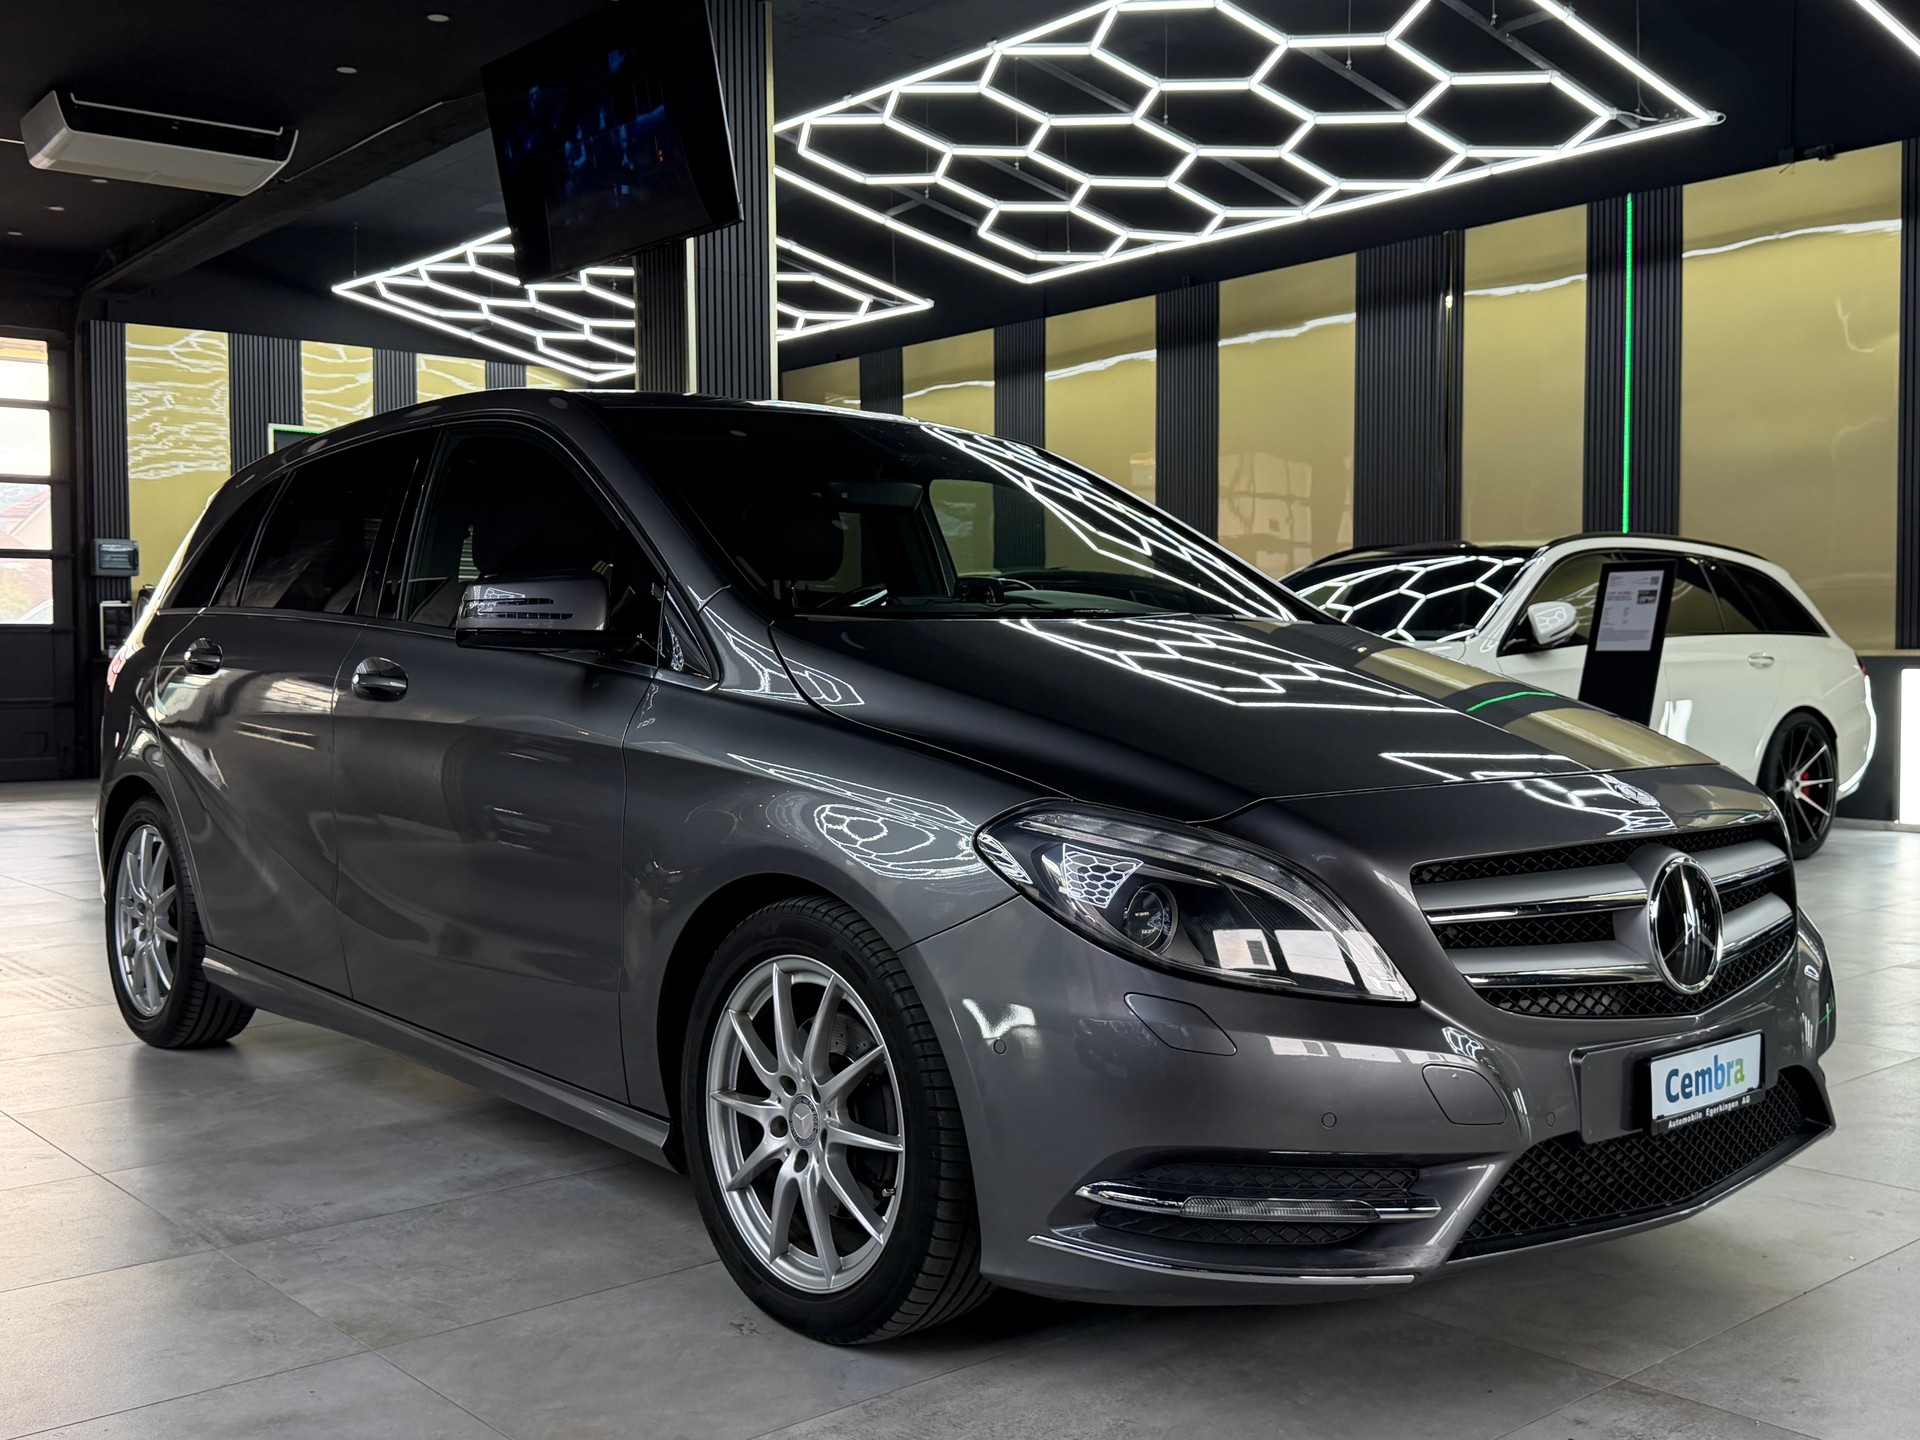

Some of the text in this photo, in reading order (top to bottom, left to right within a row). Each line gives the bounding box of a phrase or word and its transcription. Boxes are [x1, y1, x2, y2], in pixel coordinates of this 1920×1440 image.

[1665, 1054, 1745, 1103] Cembra
[1668, 1095, 1751, 1129] Automobile Egerkingen AG
